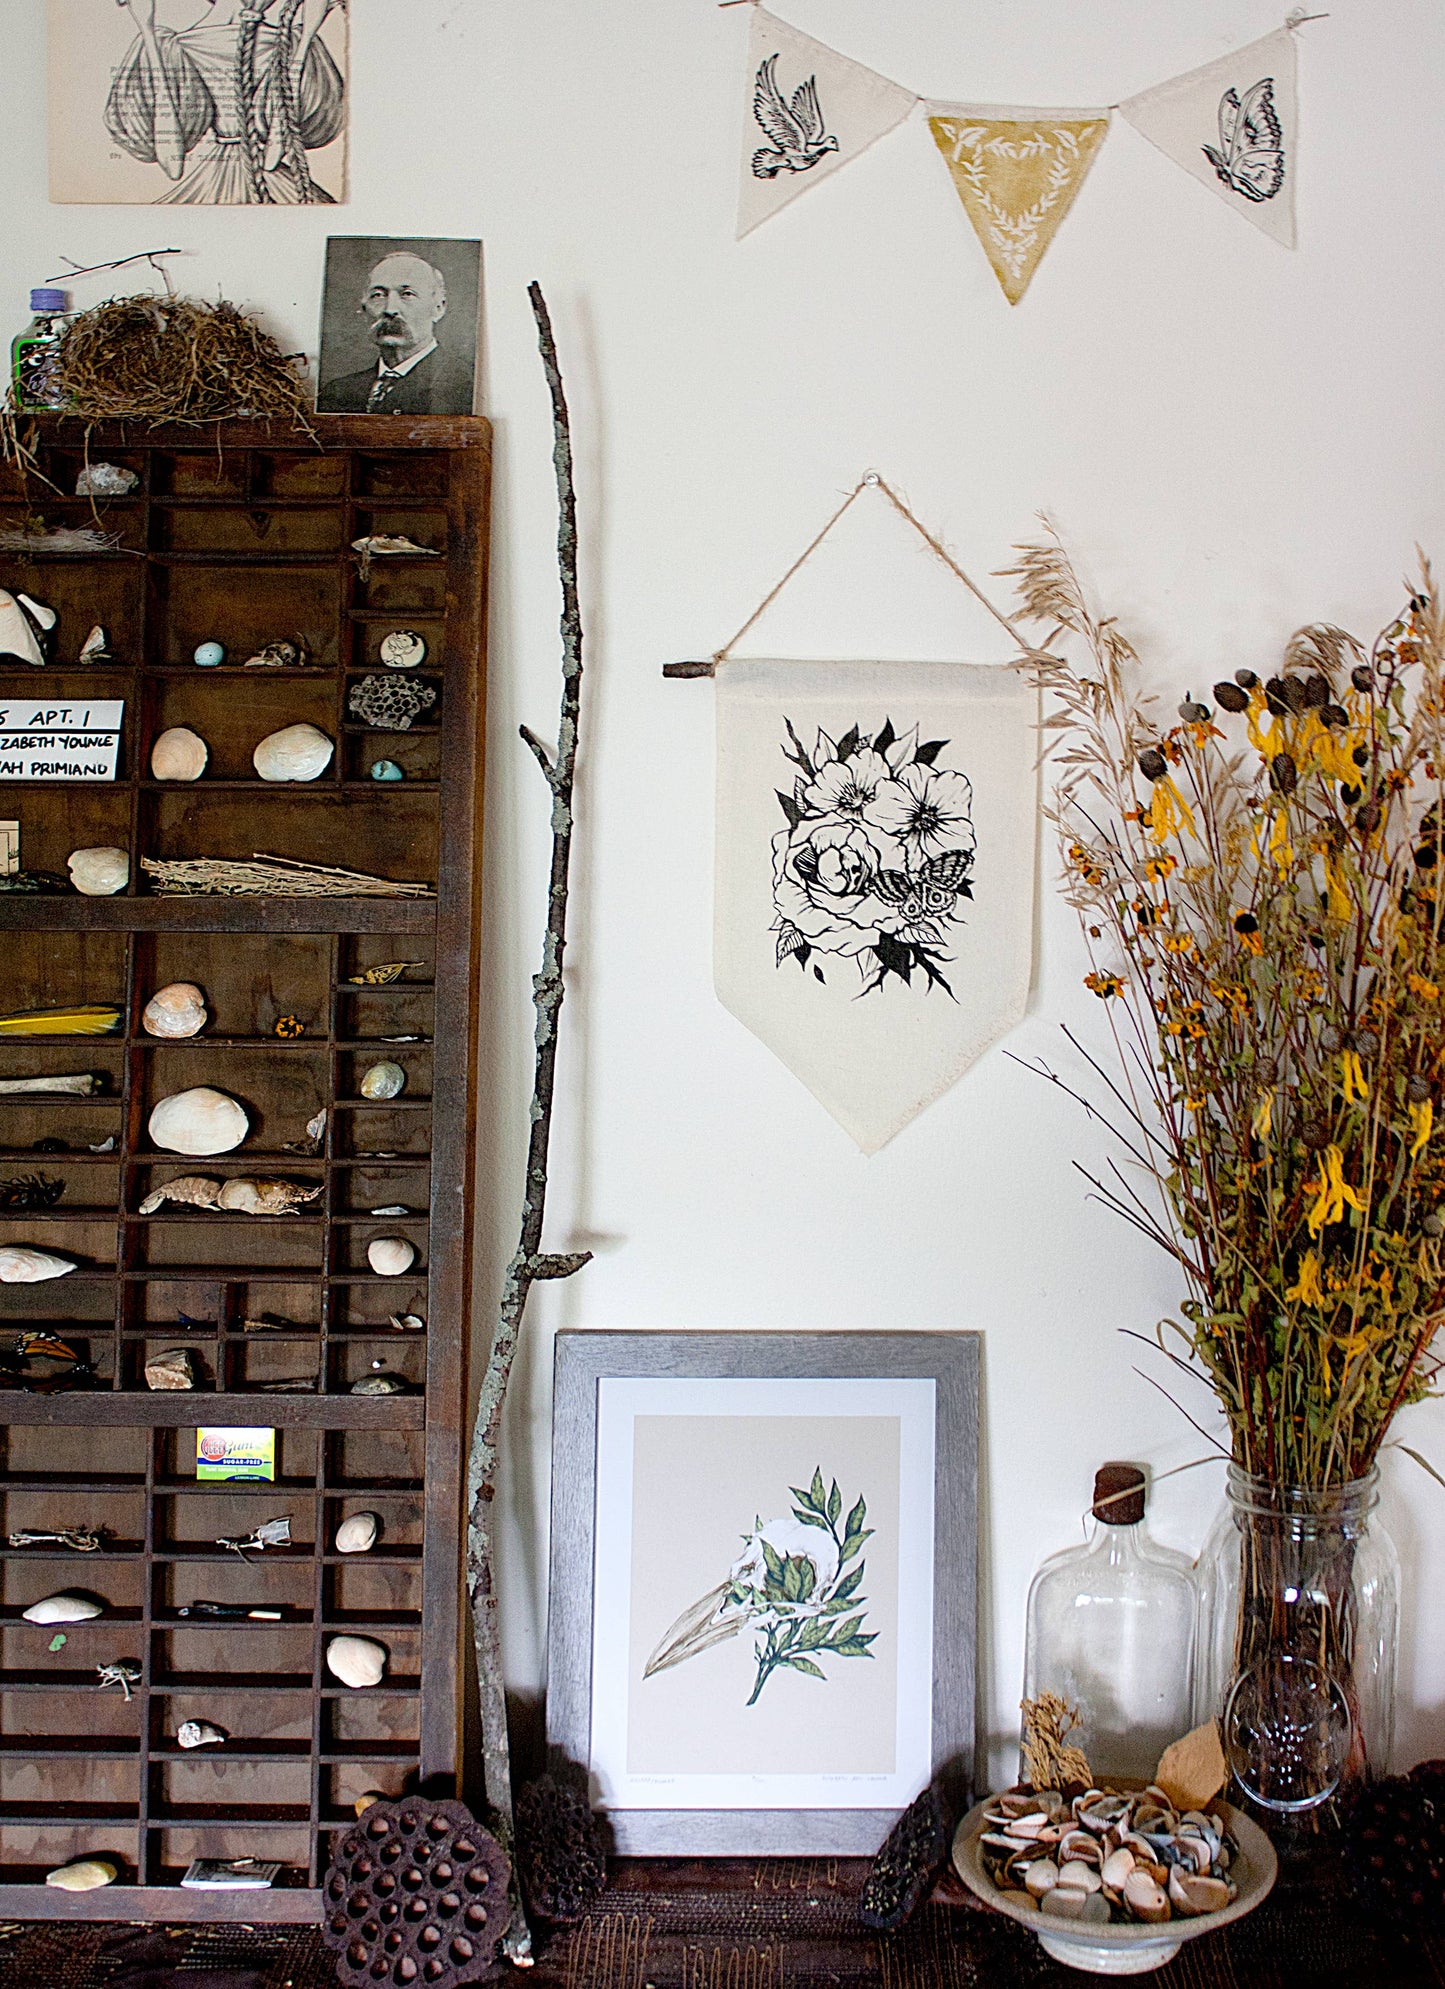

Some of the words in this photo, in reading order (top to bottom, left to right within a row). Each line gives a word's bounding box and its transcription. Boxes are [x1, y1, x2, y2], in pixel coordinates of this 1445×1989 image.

[28, 709, 73, 726] APT.
[0, 736, 55, 750] ZABETH
[224, 1440, 254, 1455] Gum
